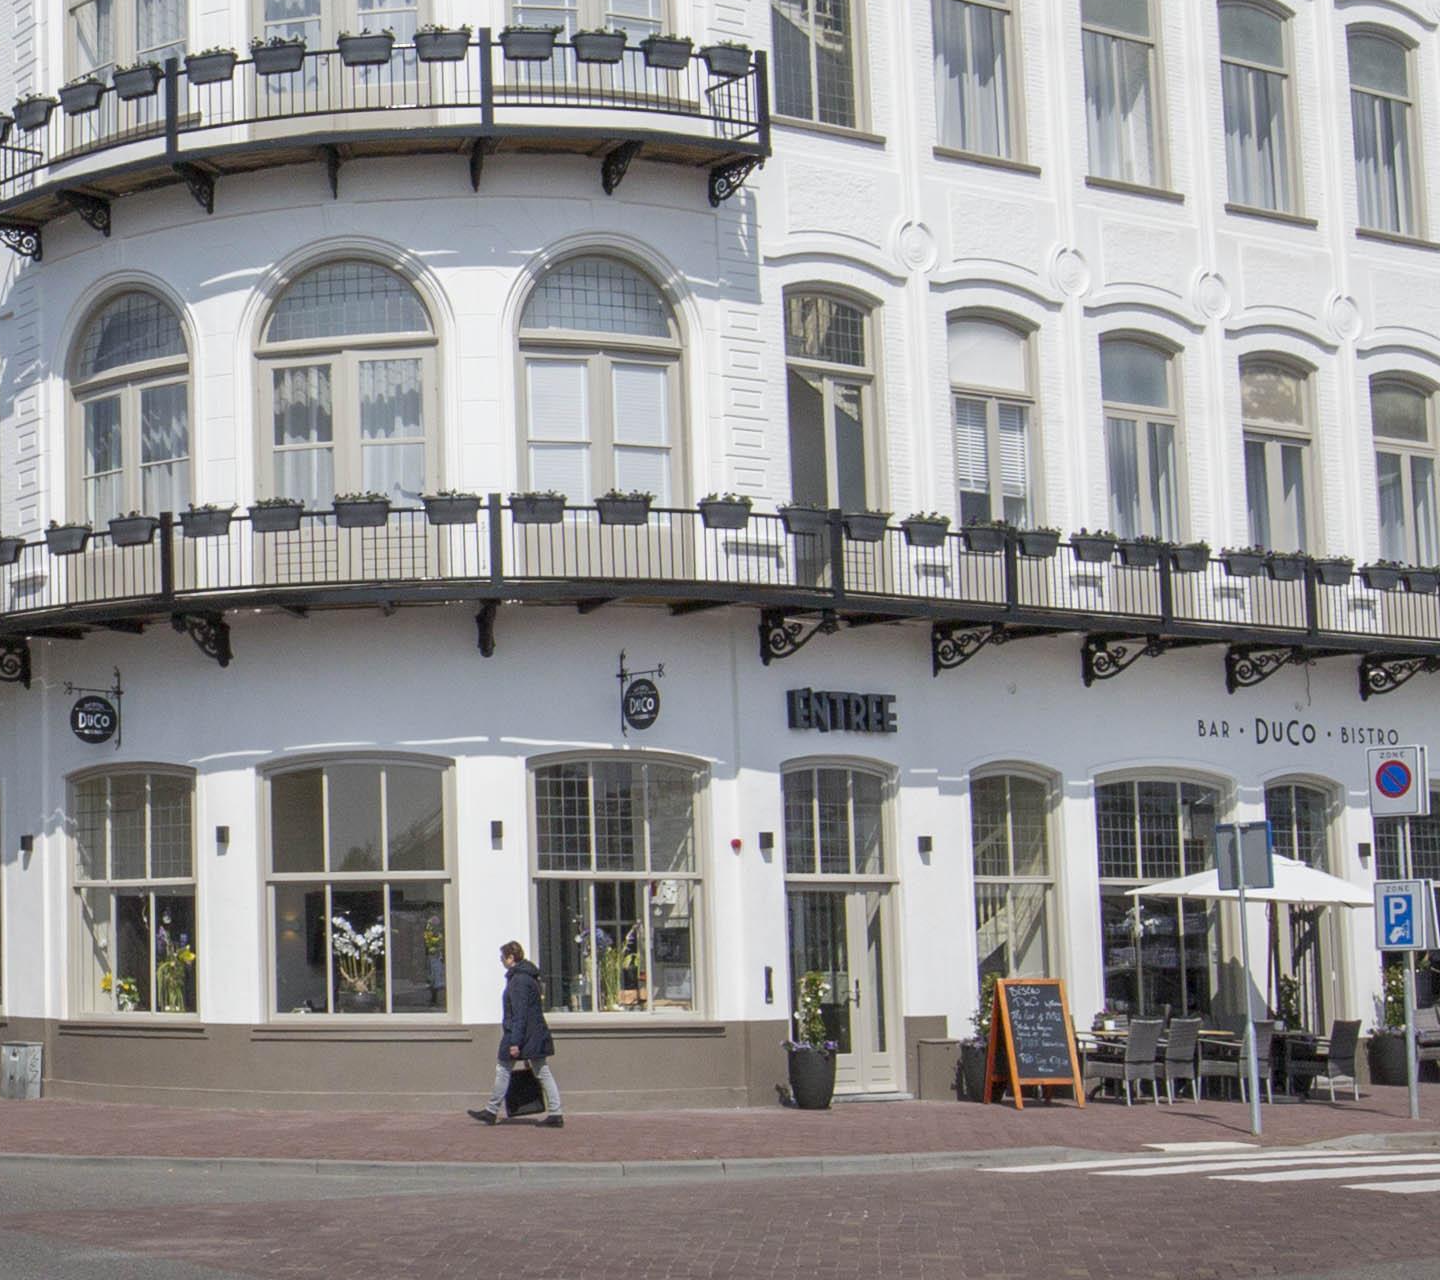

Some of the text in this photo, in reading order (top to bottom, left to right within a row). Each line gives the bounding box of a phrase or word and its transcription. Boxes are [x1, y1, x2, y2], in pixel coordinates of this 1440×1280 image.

[785, 687, 898, 733] ENTREE
[1198, 719, 1230, 738] BAR
[1341, 726, 1399, 746] BISTRO
[1379, 751, 1406, 759] ZONE
[1385, 885, 1411, 893] ZONE
[1388, 897, 1409, 925] P
